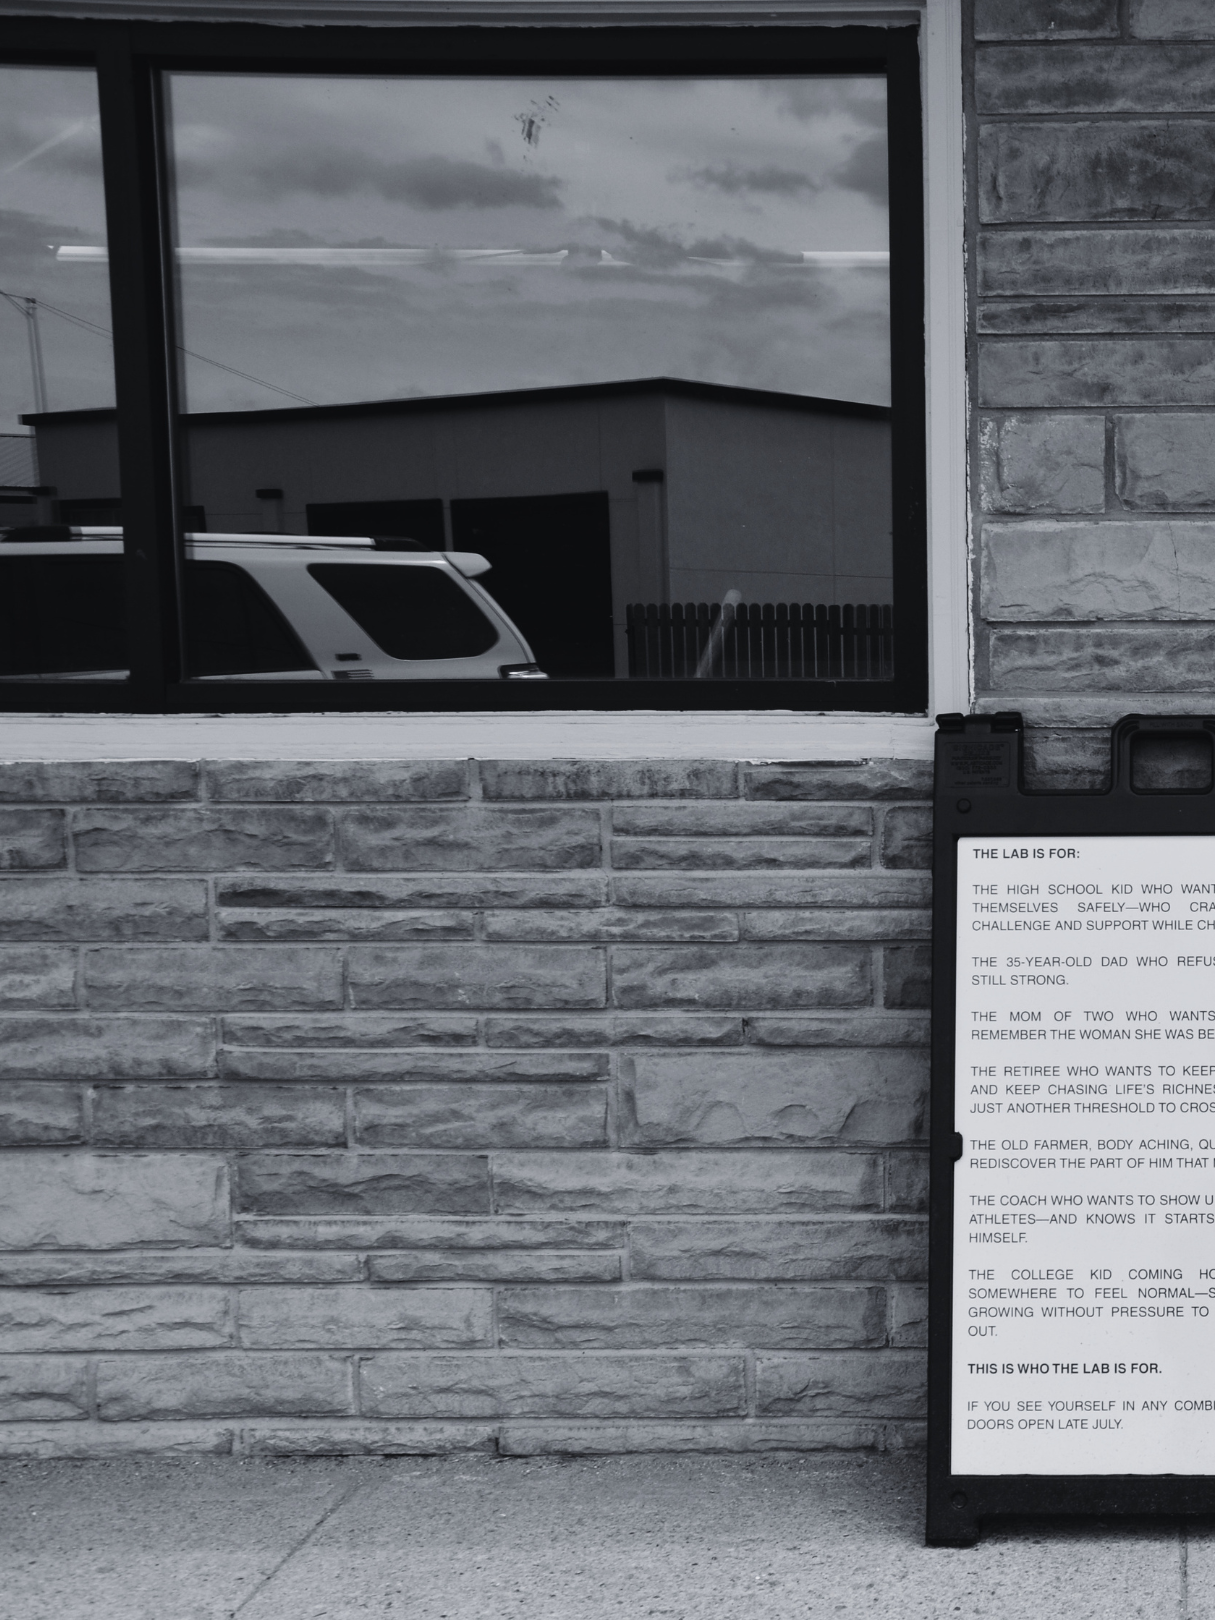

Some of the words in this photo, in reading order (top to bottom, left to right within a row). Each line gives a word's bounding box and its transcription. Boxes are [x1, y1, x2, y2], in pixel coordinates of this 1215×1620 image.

[973, 849, 998, 859] THE
[1003, 849, 1028, 859] LAB
[1033, 848, 1044, 859] IS
[1049, 848, 1080, 858] FOR:
[972, 885, 998, 895] THE
[1007, 884, 1039, 895] HIGH
[1048, 884, 1103, 895] SCHOOL
[1112, 884, 1133, 894] KID
[1141, 884, 1173, 894] WHO
[972, 902, 1058, 913] THEMSELVES
[972, 920, 1050, 931] CHALLENGE
[1055, 920, 1082, 930] AND
[1086, 920, 1149, 930] SUPPORT
[1152, 920, 1193, 930] WHILE
[972, 957, 997, 967] THE
[1007, 957, 1092, 967] 35-YEAR-OLD
[1102, 957, 1128, 967] DAD
[1136, 956, 1168, 966] WHO
[972, 975, 1006, 985] STILL
[1010, 975, 1069, 985] STRONG.
[971, 1011, 997, 1021] THE
[1010, 1011, 1041, 1022] MOM
[1054, 1011, 1072, 1021] OF
[1084, 1011, 1114, 1021] TWO
[1126, 1011, 1157, 1021] WHO
[1169, 1010, 1215, 1021] WANTS
[972, 1030, 1046, 1040] REMEMBER
[1050, 1029, 1075, 1039] THE
[1079, 1029, 1130, 1040] WOMAN
[1135, 1029, 1161, 1039] SHE
[1165, 1029, 1194, 1039] WAS
[971, 1066, 996, 1076] THE
[1004, 1066, 1060, 1076] RETIREE
[1067, 1066, 1099, 1076] WHO
[1105, 1066, 1151, 1076] WANTS
[1158, 1065, 1175, 1076] TO
[970, 1085, 998, 1095] AND
[1006, 1085, 1040, 1095] KEEP
[1048, 1084, 1107, 1095] CHASING
[970, 1103, 1003, 1113] JUST
[1007, 1103, 1070, 1113] ANOTHER
[1074, 1102, 1155, 1113] THRESHOLD
[1158, 1102, 1176, 1113] TO
[970, 1140, 995, 1150] THE
[1001, 1140, 1028, 1150] OLD
[1034, 1140, 1092, 1151] FARMER,
[1098, 1139, 1133, 1150] BODY
[1139, 1139, 1193, 1151] ACHING,
[970, 1158, 1056, 1169] REDISCOVER
[1060, 1158, 1085, 1168] THE
[1090, 1158, 1123, 1168] PART
[1127, 1158, 1145, 1168] OF
[1149, 1158, 1172, 1168] HIM
[1176, 1158, 1209, 1168] THAT
[969, 1195, 995, 1206] THE
[1000, 1195, 1046, 1206] COACH
[1051, 1195, 1083, 1206] WHO
[1087, 1195, 1134, 1205] WANTS
[1138, 1195, 1155, 1205] TO
[1160, 1195, 1200, 1205] SHOW
[1086, 1213, 1135, 1224] KNOWS
[1145, 1214, 1156, 1224] IT
[1165, 1213, 1214, 1224] STARTS
[969, 1232, 1028, 1243] HIMSELF.
[969, 1269, 994, 1280] THE
[1011, 1269, 1073, 1280] COLLEGE
[1091, 1269, 1112, 1280] KID
[1129, 1269, 1182, 1280] COMING
[969, 1288, 1057, 1299] SOMEWHERE
[1067, 1288, 1084, 1299] TO
[1095, 1288, 1128, 1298] FEEL
[968, 1307, 1033, 1317] GROWING
[1041, 1307, 1103, 1317] WITHOUT
[1112, 1306, 1184, 1317] PRESSURE
[1191, 1306, 1209, 1317] TO
[968, 1326, 998, 1336] OUT.
[967, 1363, 997, 1374] THIS
[1002, 1363, 1014, 1374] IS
[1017, 1363, 1049, 1374] WHO
[1052, 1363, 1079, 1374] THE
[1083, 1363, 1110, 1374] LAB
[1114, 1363, 1126, 1374] IS
[1131, 1363, 1163, 1374] FOR.
[968, 1401, 978, 1411] IF
[984, 1401, 1010, 1411] YOU
[1017, 1401, 1042, 1411] SEE
[1048, 1401, 1116, 1411] YOURSELF
[1123, 1401, 1134, 1411] IN
[1142, 1401, 1167, 1411] ANY
[968, 1419, 1014, 1429] DOORS
[1018, 1419, 1054, 1429] OPEN
[1059, 1419, 1088, 1429] LATE
[1092, 1419, 1124, 1429] JULY.
